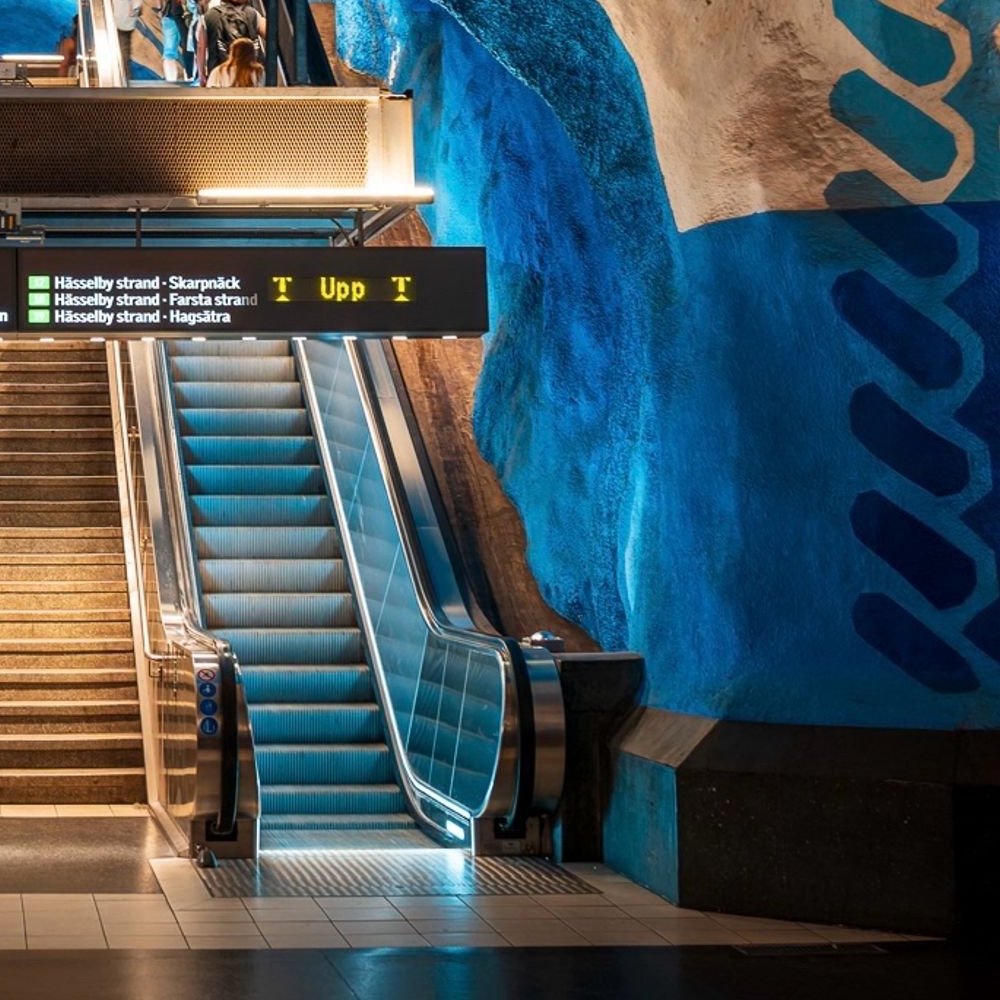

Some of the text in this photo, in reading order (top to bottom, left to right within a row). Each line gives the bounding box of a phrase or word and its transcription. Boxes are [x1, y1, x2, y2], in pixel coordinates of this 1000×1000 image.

[55, 275, 114, 292] Hässelby
[116, 275, 160, 289] strand
[169, 275, 241, 292] Skarpnäck
[320, 276, 366, 302] Upp
[55, 292, 114, 309] Hässelby
[116, 292, 160, 306] strand
[169, 292, 212, 306] Farsta
[214, 292, 258, 306] strand
[55, 308, 115, 326] Hässelby
[116, 308, 160, 322] strand
[169, 308, 231, 326] Hagsätra
